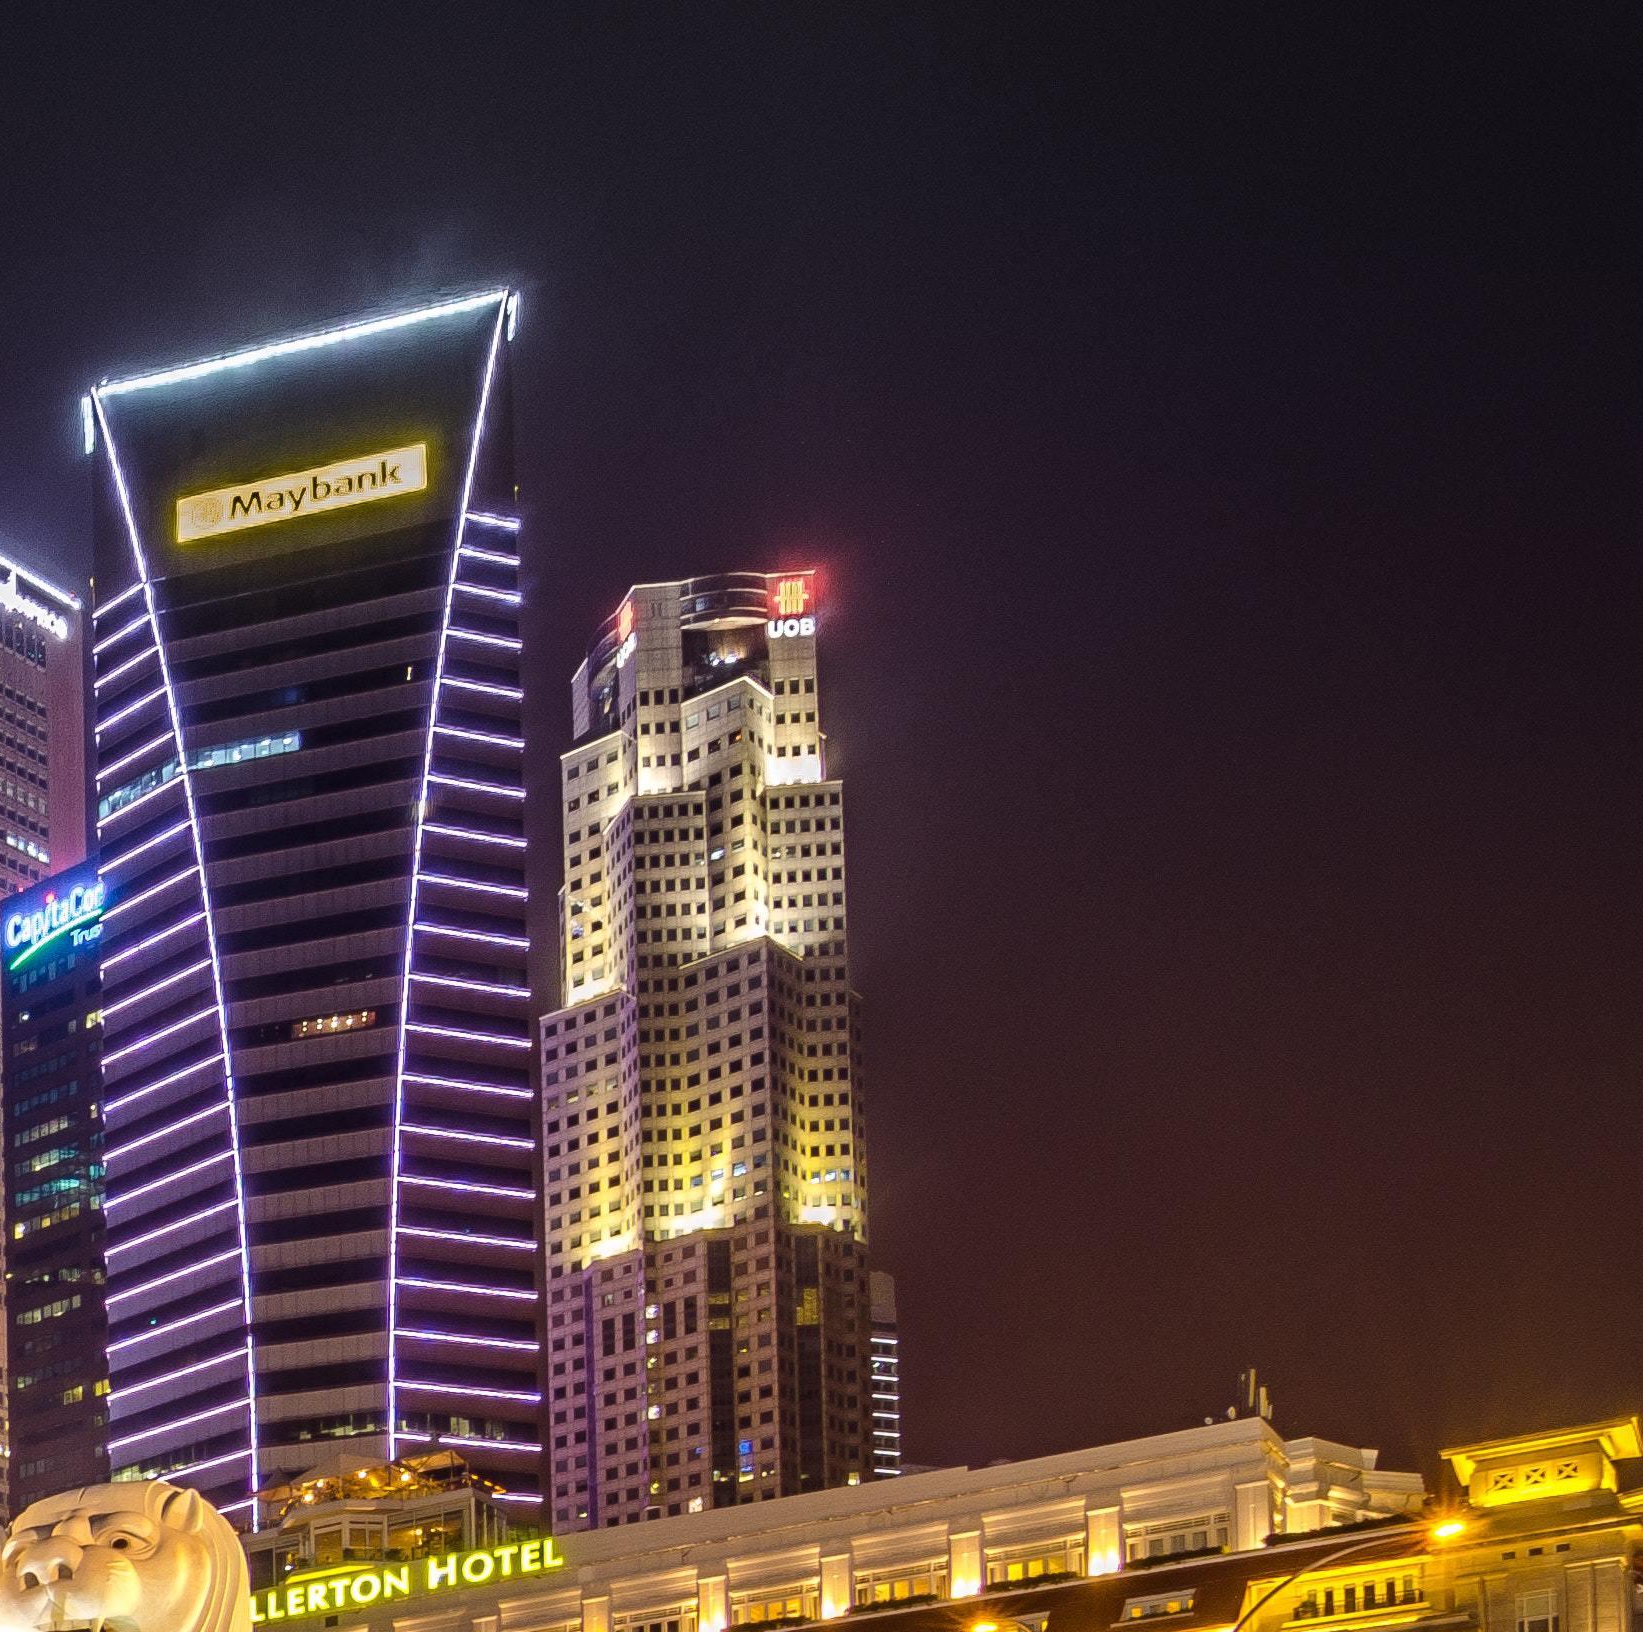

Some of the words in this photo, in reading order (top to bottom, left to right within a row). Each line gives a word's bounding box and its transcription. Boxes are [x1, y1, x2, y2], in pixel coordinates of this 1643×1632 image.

[229, 459, 403, 520] Maybank
[767, 617, 816, 639] UOB
[427, 1538, 564, 1590] HOTEL
